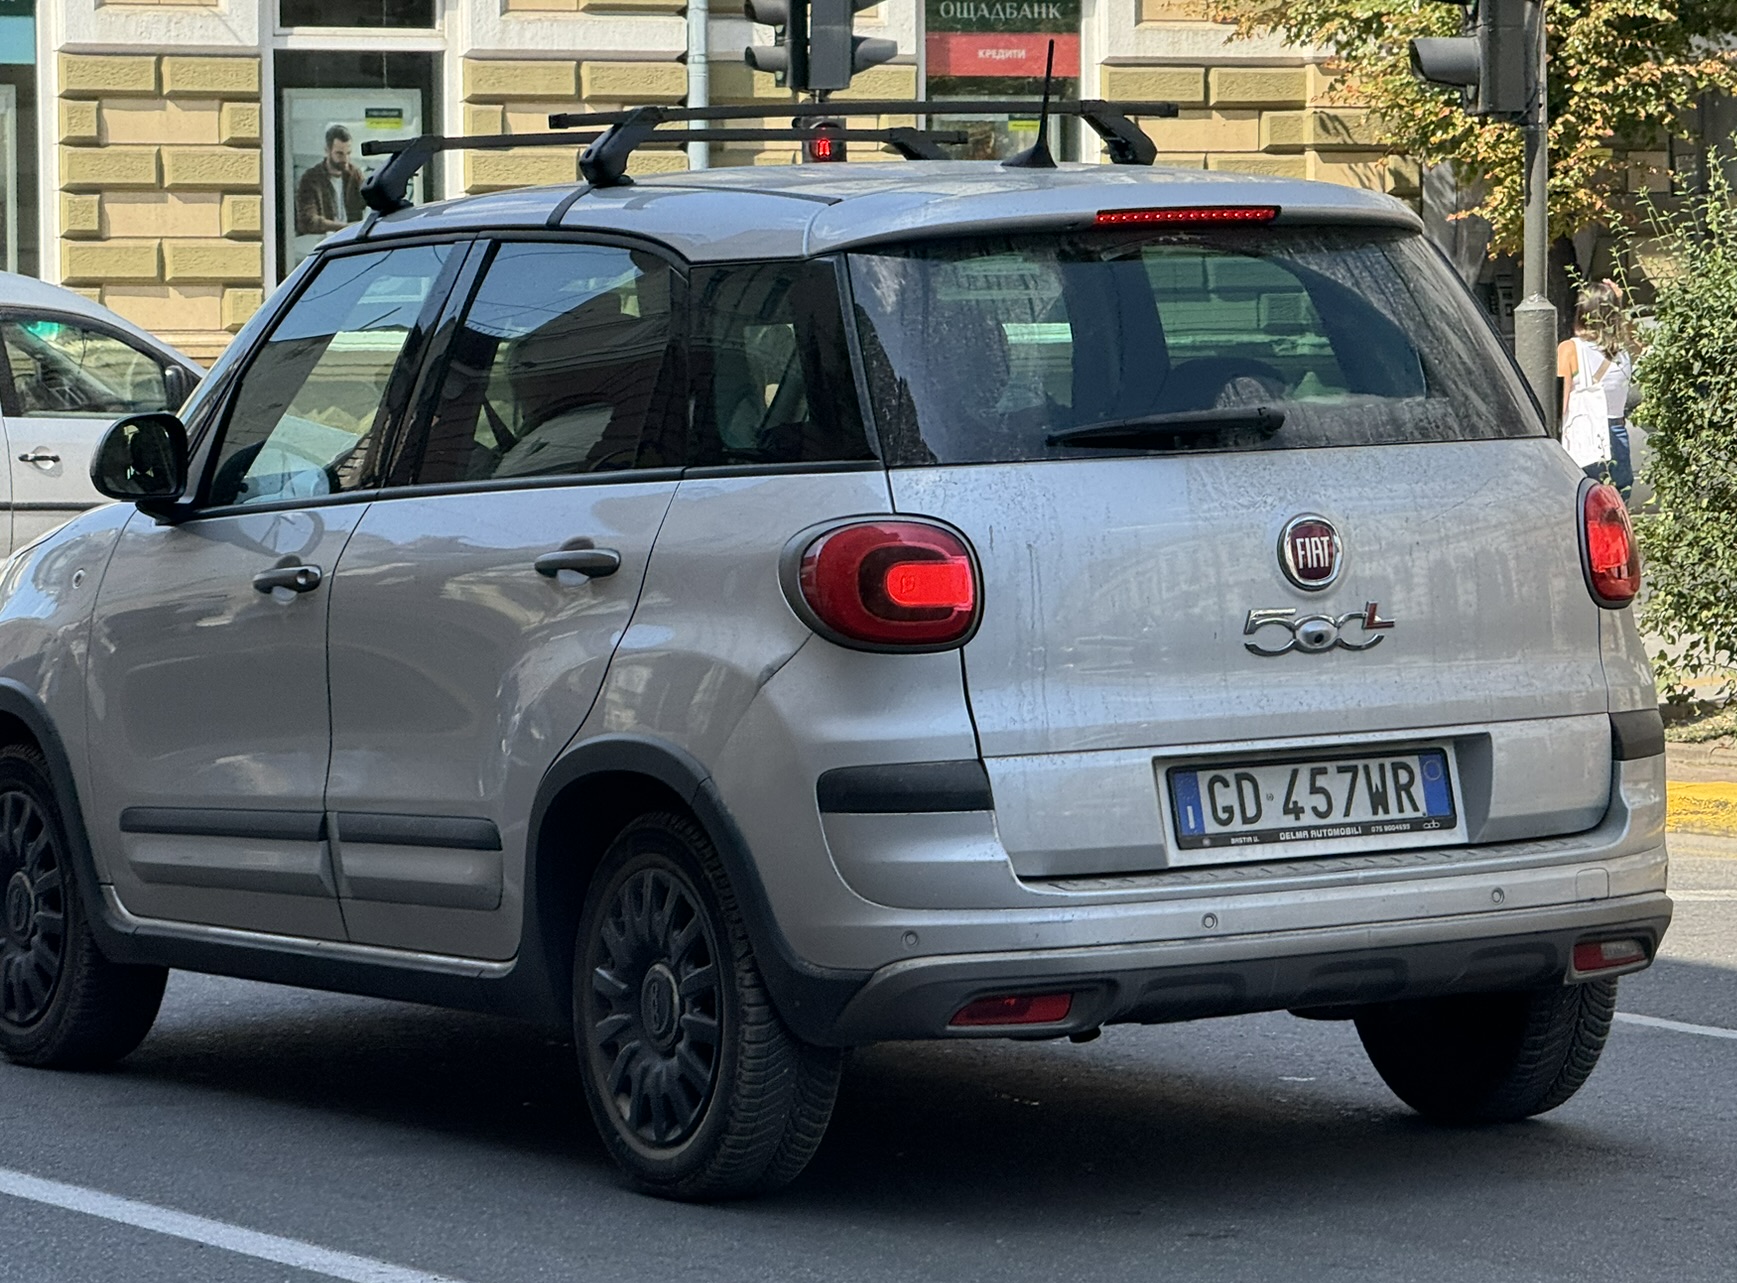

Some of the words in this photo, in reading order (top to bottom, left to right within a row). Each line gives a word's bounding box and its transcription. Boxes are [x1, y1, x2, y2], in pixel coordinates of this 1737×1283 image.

[939, 2, 1062, 22] ОЩАДБАНК
[977, 49, 1027, 60] КРЕДИТИ
[1295, 536, 1330, 569] FIAT
[1243, 601, 1396, 657] 500L
[1207, 772, 1262, 827] GD
[1282, 761, 1421, 821] 457WR
[1310, 826, 1362, 839] AUTOMOBILI
